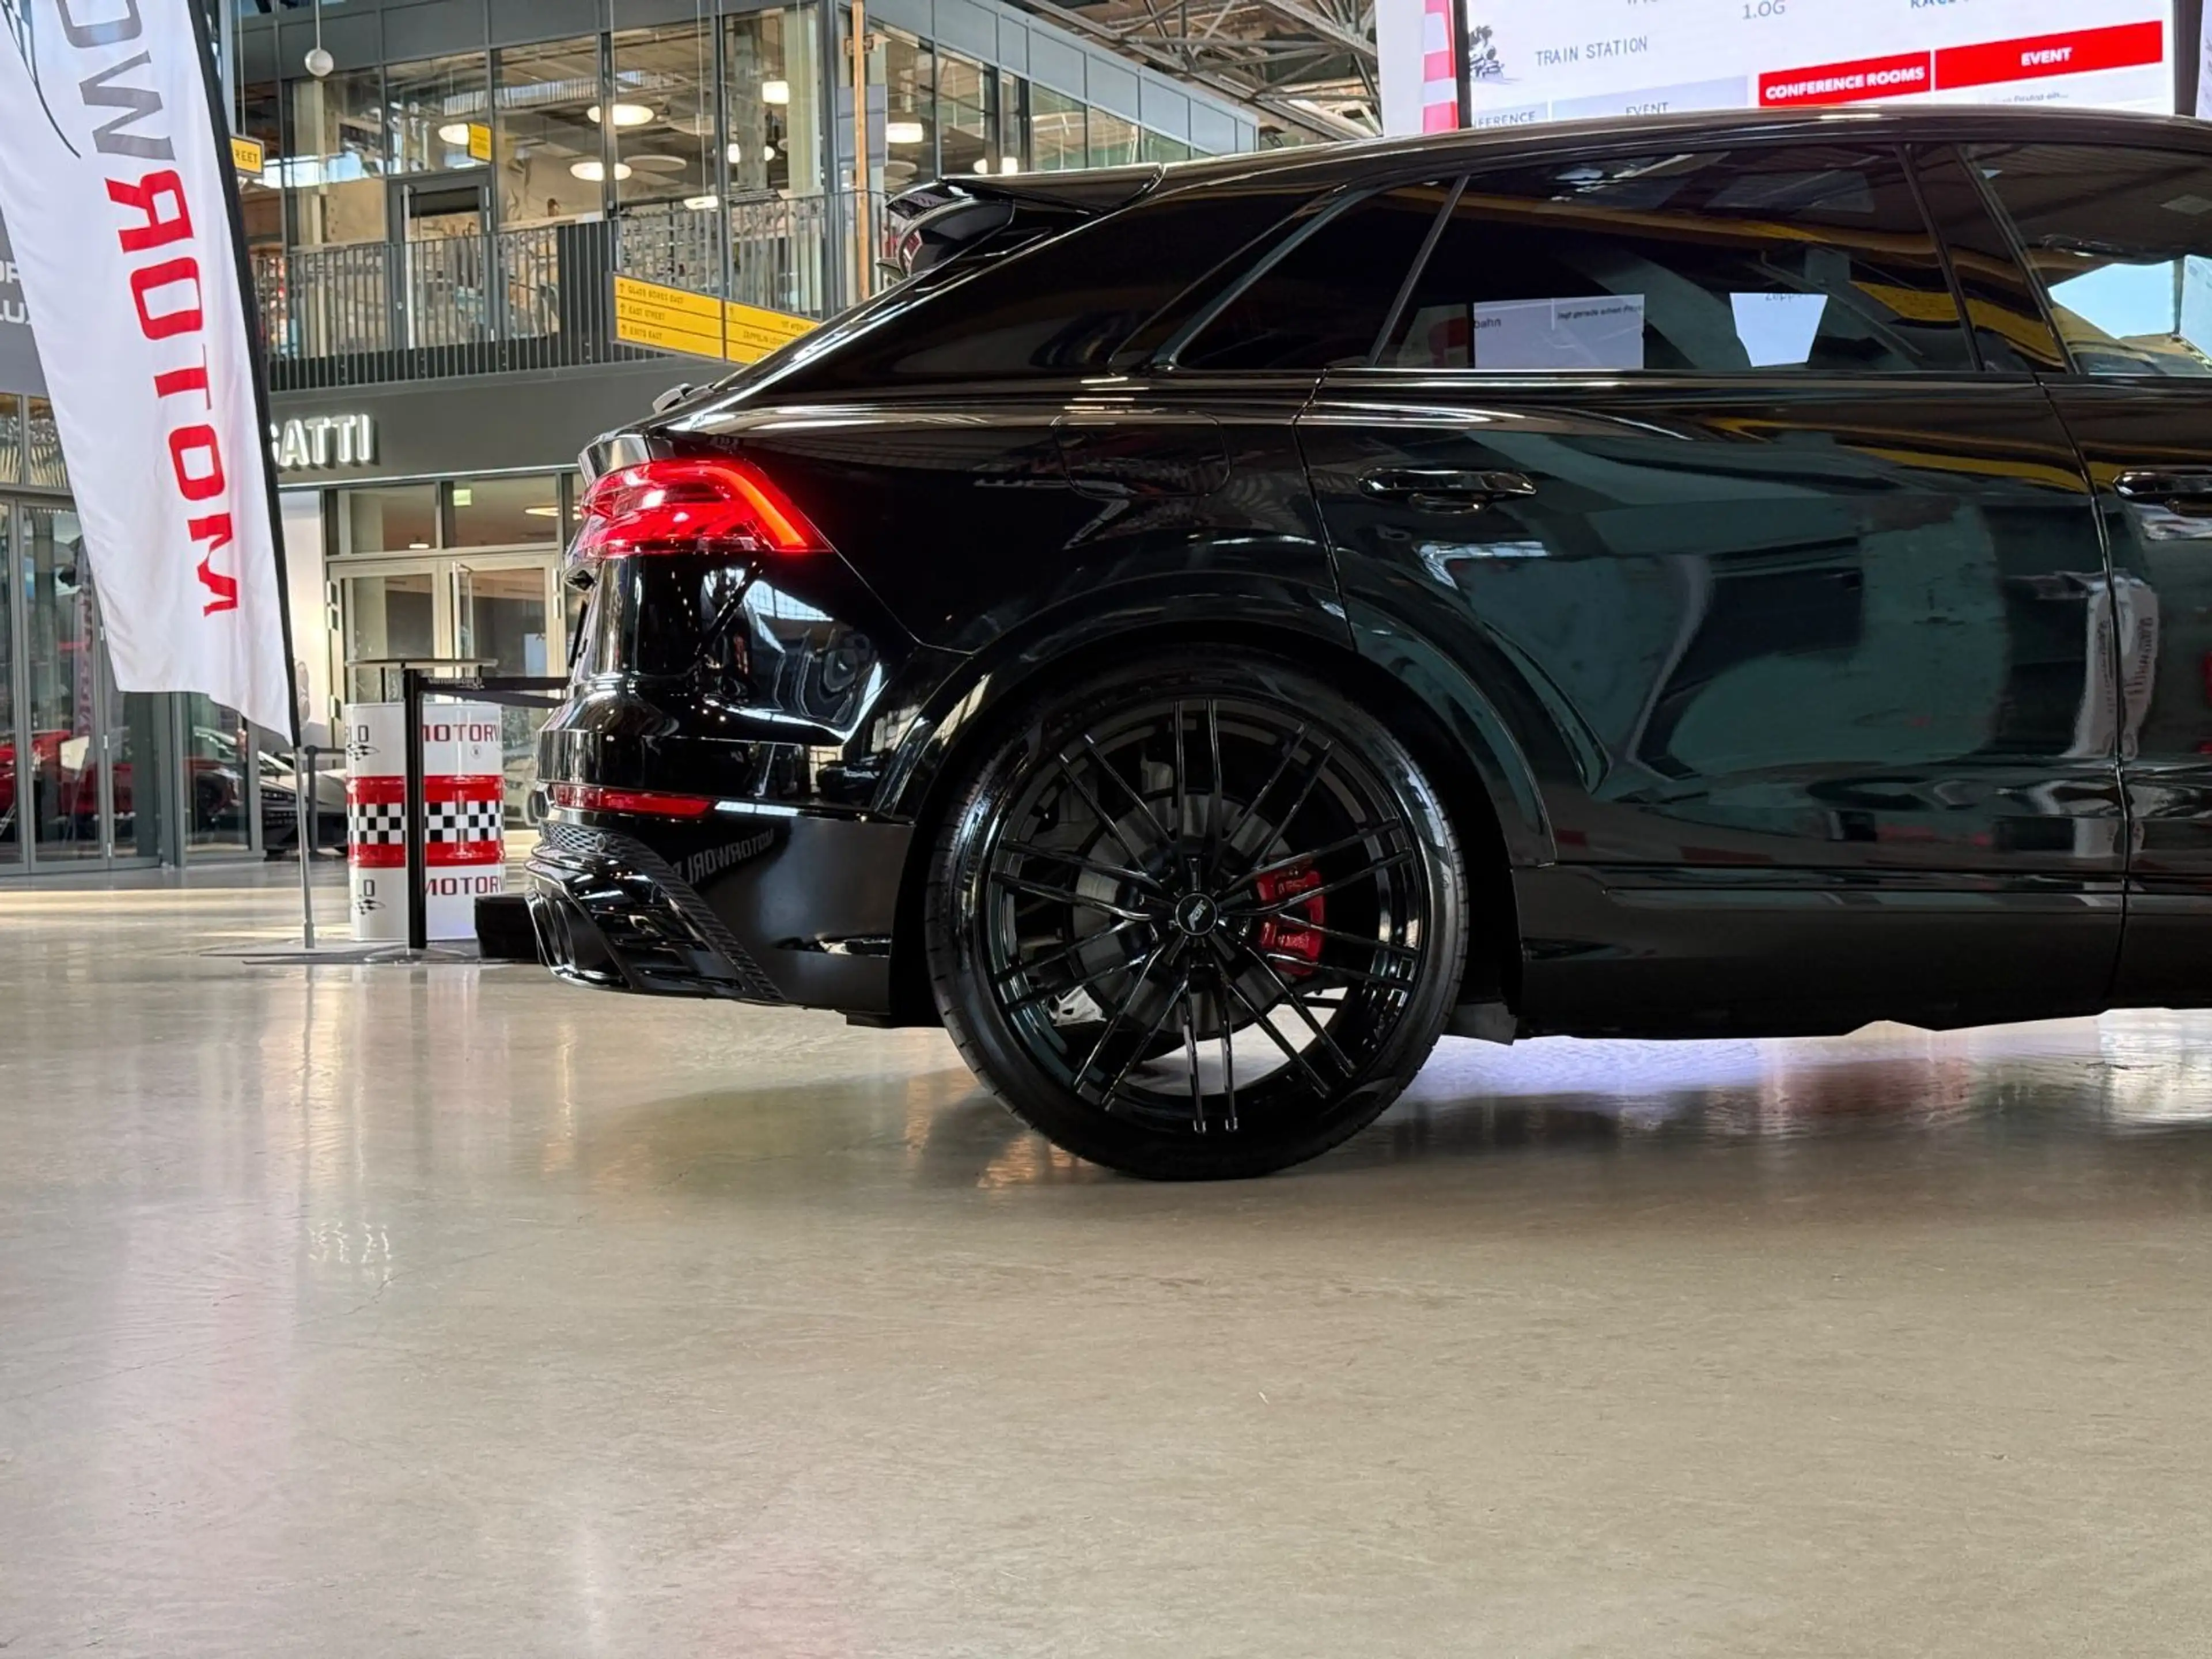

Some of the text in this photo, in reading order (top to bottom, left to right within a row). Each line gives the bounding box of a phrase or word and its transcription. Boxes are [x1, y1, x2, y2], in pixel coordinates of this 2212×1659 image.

[1535, 36, 1647, 66] TRAIN STATION
[2021, 47, 2073, 66] EVENT
[1766, 66, 1925, 100] CONFERENCE ROOMS
